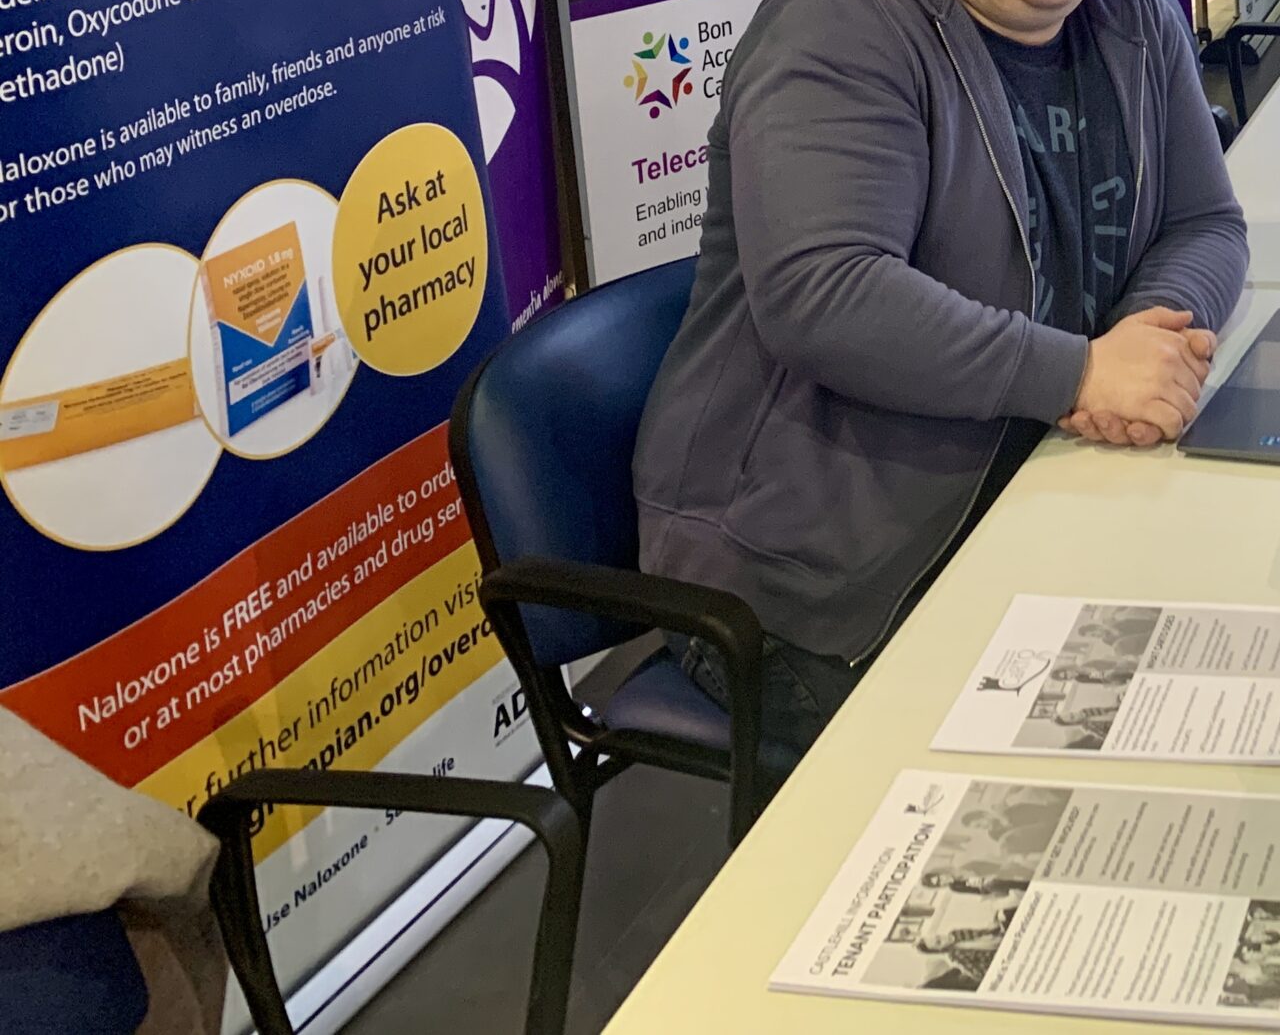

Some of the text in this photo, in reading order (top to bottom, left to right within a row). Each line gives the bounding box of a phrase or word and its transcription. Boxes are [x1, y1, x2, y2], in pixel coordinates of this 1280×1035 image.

[698, 20, 733, 44] Bon
[101, 126, 117, 152] is
[119, 96, 192, 147] available
[194, 91, 213, 114] to
[214, 72, 271, 110] family,
[272, 50, 323, 91] friends
[326, 41, 356, 68] and
[358, 26, 412, 61] anyone
[413, 16, 427, 37] at
[427, 6, 447, 31] risk
[24, 80, 339, 215] those who may witness an overdose.
[376, 169, 448, 225] Ask at
[635, 188, 702, 222] Enabling
[638, 225, 667, 249] and
[223, 258, 266, 288] NYXOID
[358, 204, 470, 292] your local
[364, 256, 477, 342] pharmacy
[77, 488, 418, 732] Naloxone is FREE and available to
[122, 721, 151, 751] or
[154, 703, 182, 732] at
[184, 663, 244, 709] most
[245, 577, 352, 672] pharmacies
[354, 547, 389, 583] and
[390, 517, 435, 560] drug
[306, 603, 442, 735] information
[443, 570, 484, 619] visi
[293, 834, 369, 910] Naloxone
[831, 822, 937, 979] TENANT PARTICIPATION
